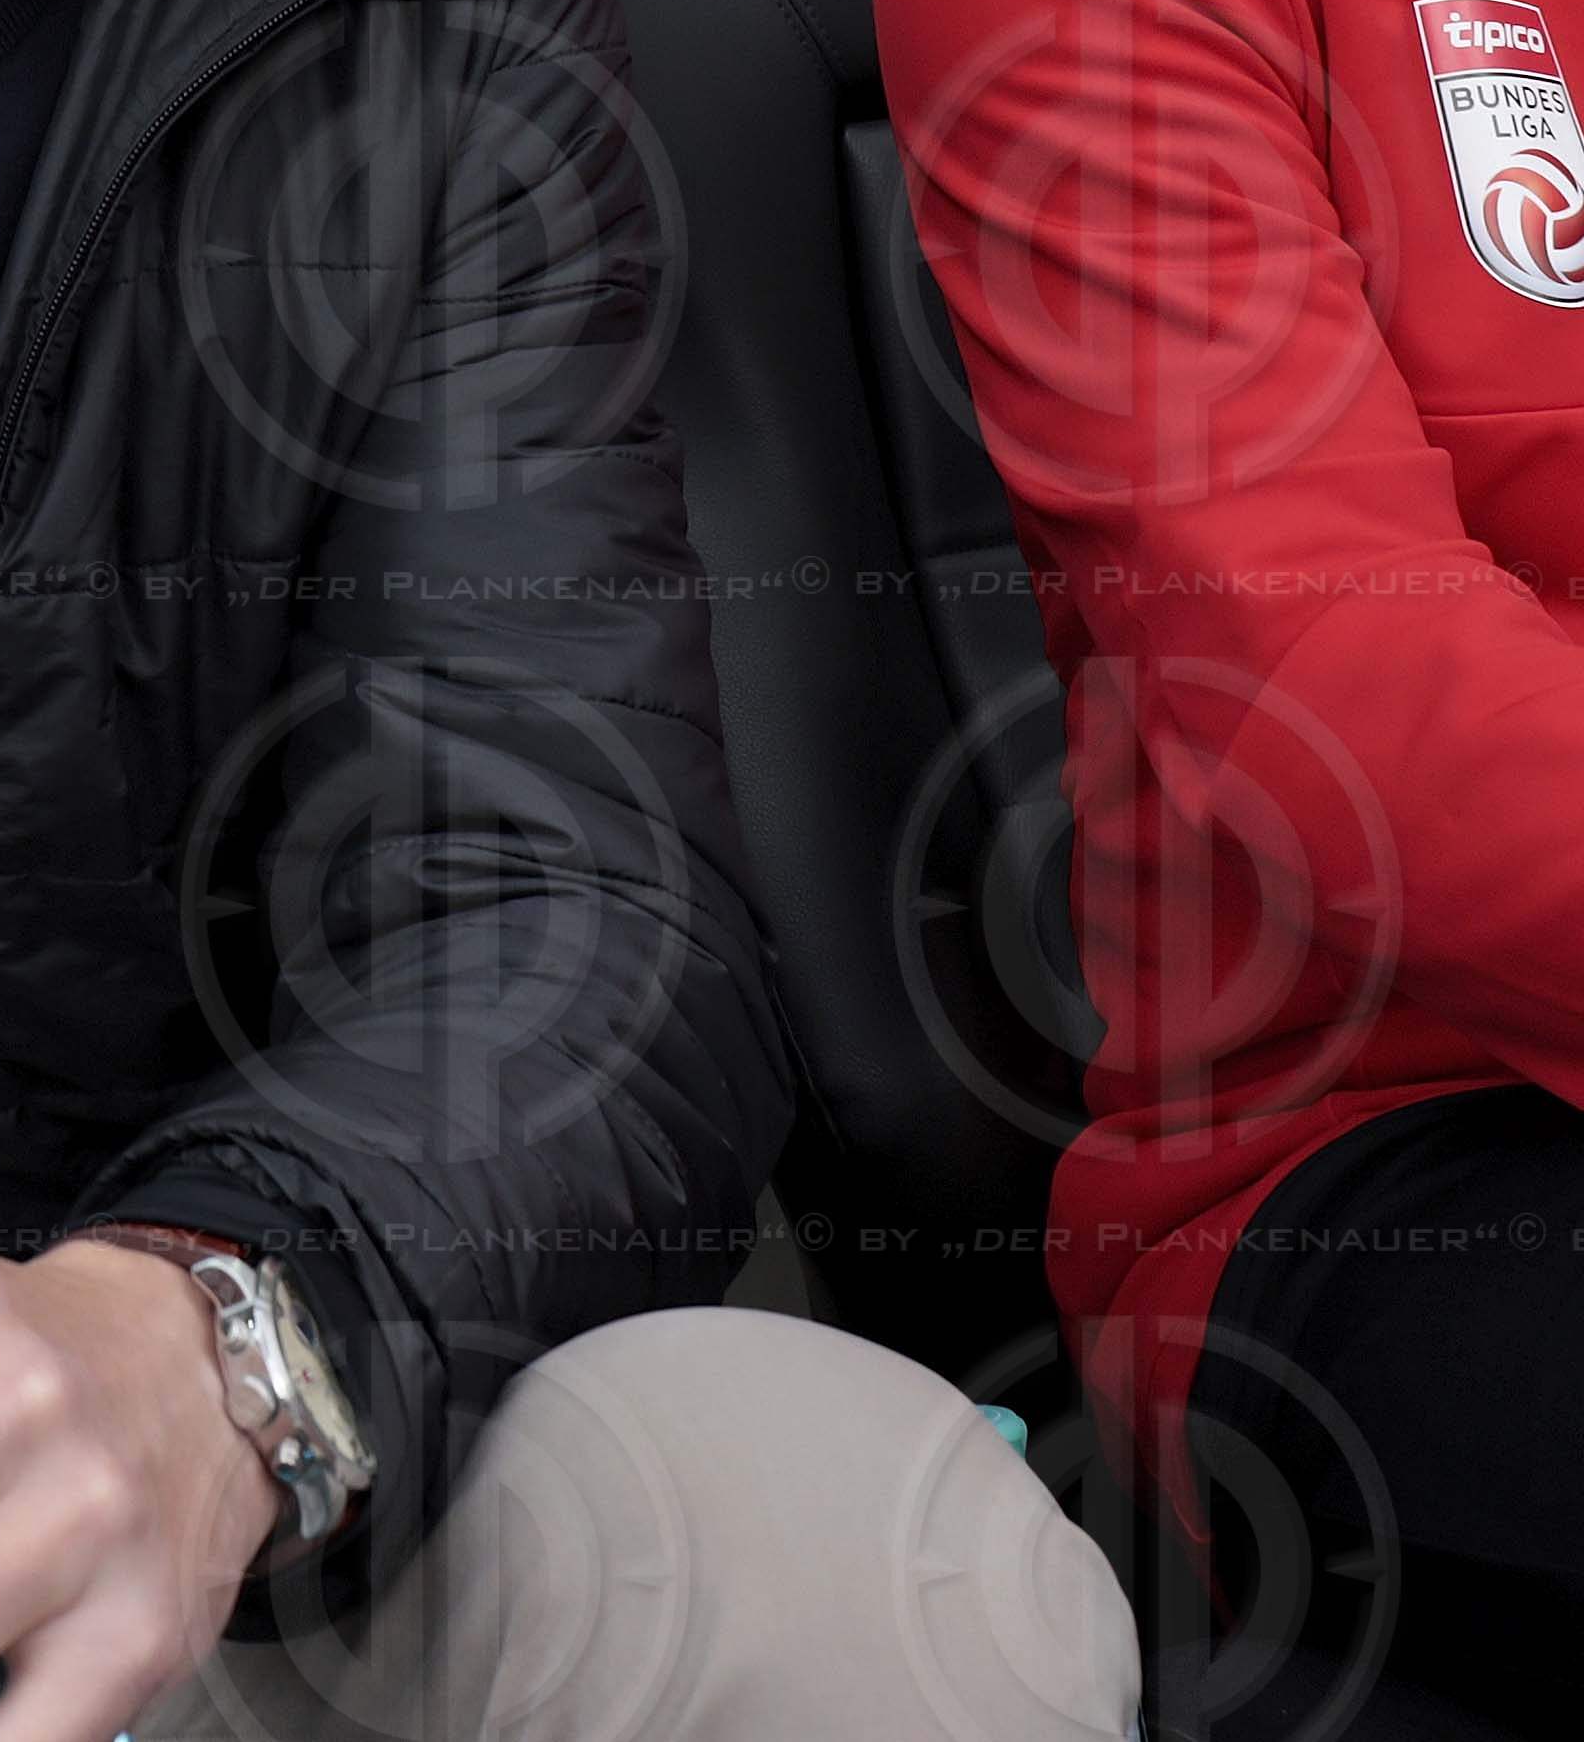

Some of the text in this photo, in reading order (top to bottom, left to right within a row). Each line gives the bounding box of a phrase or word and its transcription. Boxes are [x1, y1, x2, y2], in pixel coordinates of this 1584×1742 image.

[1443, 12, 1546, 54] tipico
[1451, 86, 1565, 114] BUNDES
[1492, 114, 1556, 140] LIGA
